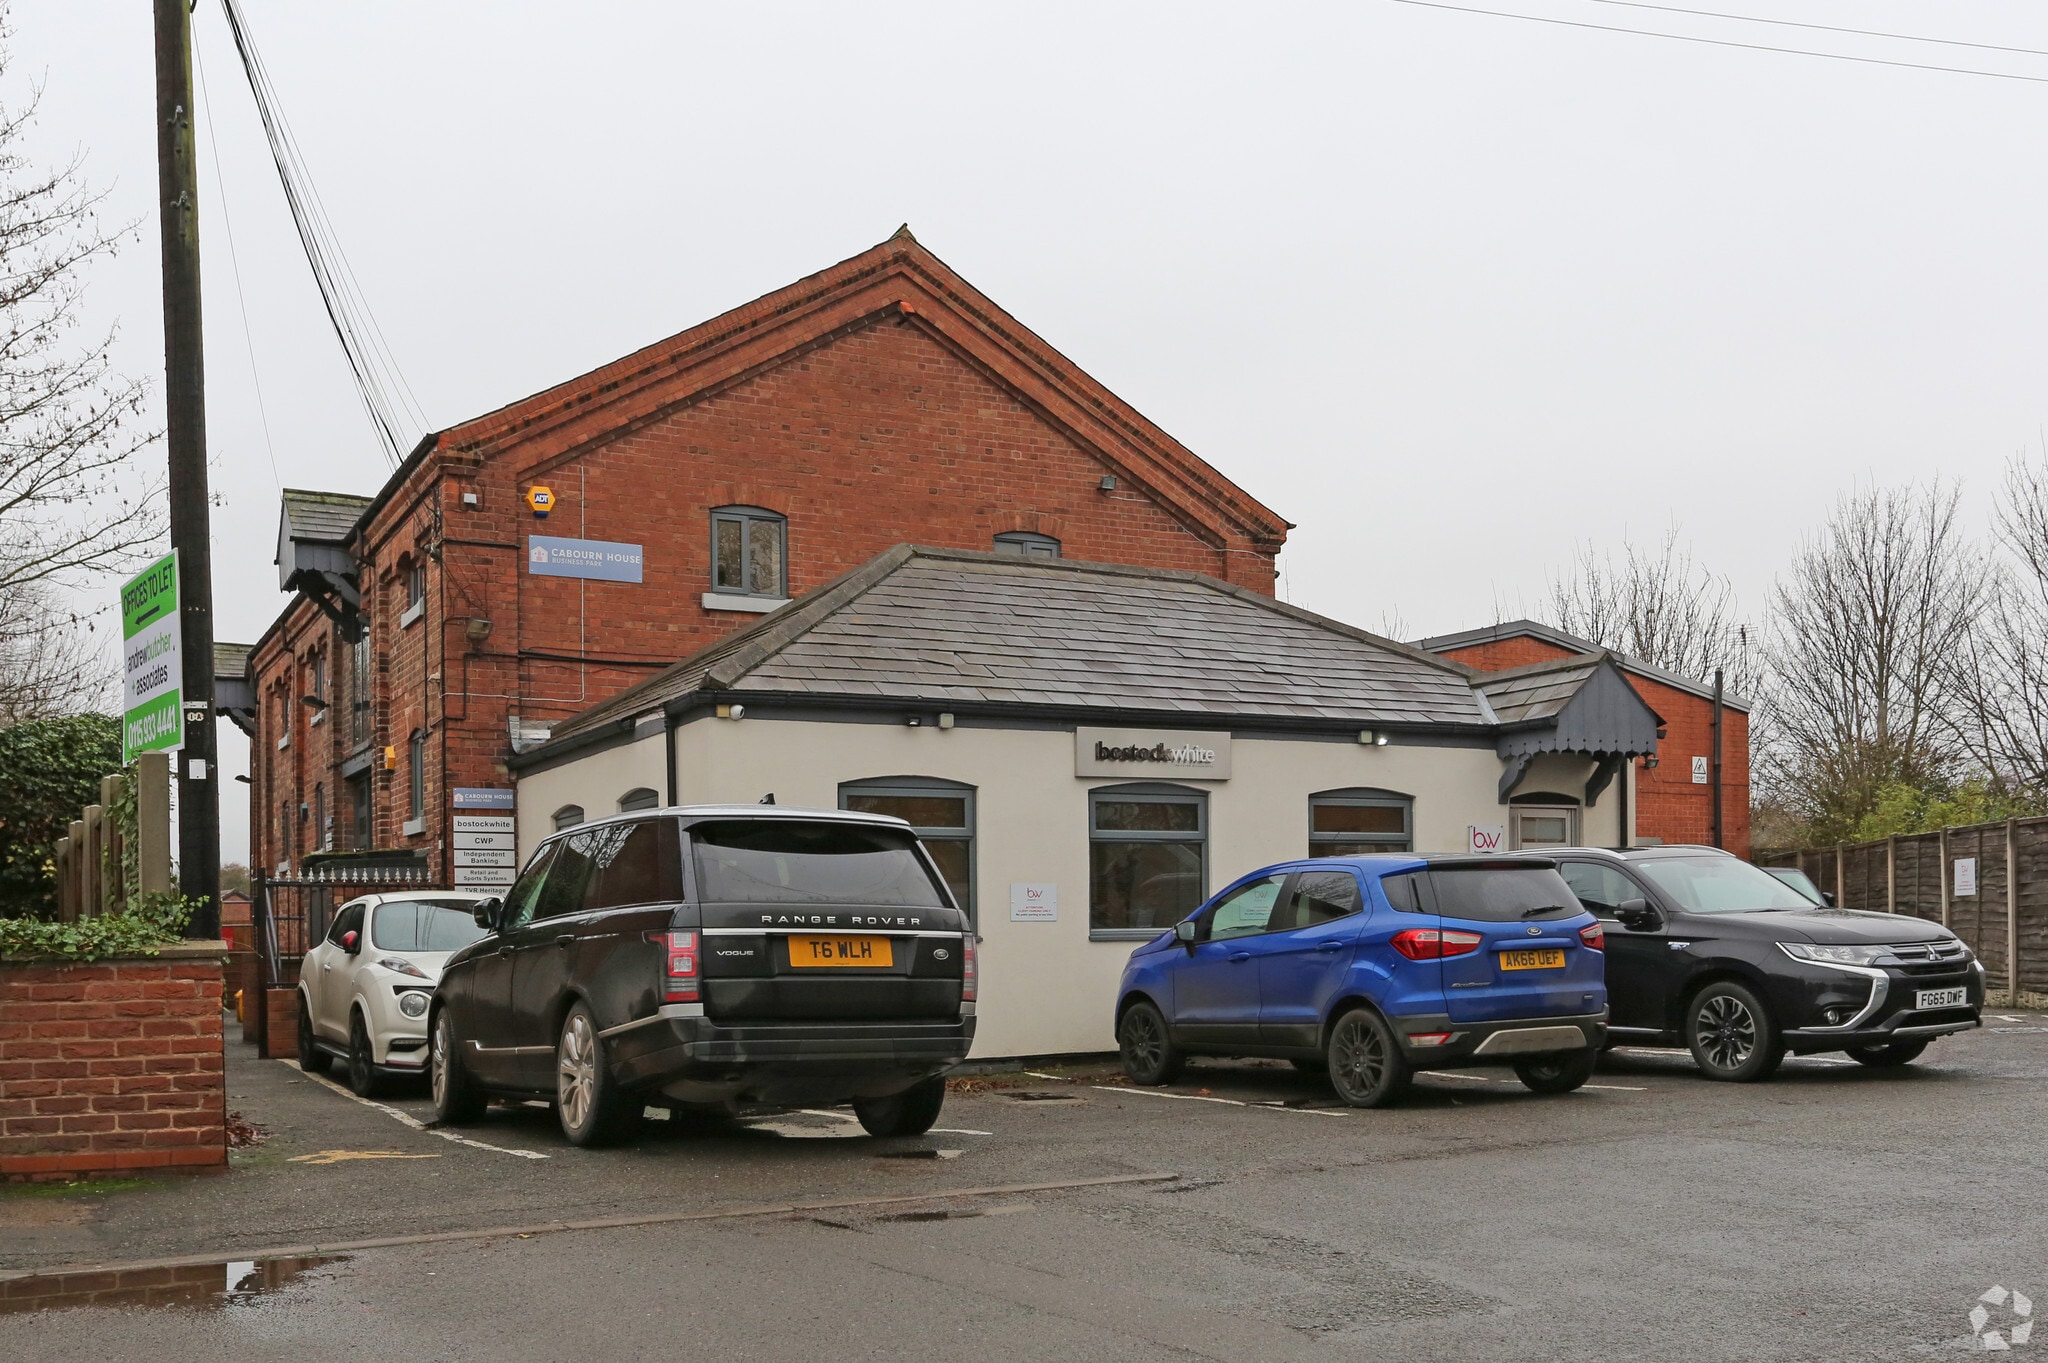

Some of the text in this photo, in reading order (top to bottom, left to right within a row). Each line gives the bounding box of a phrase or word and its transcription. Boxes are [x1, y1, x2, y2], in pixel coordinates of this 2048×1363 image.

[535, 495, 548, 503] ADT
[551, 548, 641, 565] CABOURN HOUSE
[552, 558, 602, 567] BUSINESS PARK
[124, 563, 173, 617] OFFICES TO LET
[127, 632, 171, 674] andrewbutcher
[136, 664, 168, 696] associates
[128, 704, 176, 749] 0115 933 4441
[457, 820, 511, 828] bostockwhite
[1473, 826, 1501, 848] bw
[761, 915, 920, 925] RANGE ROVER
[809, 941, 872, 959] T6 WLH
[1506, 951, 1559, 967] AK66 UEF
[1921, 992, 1945, 1006] FG65
